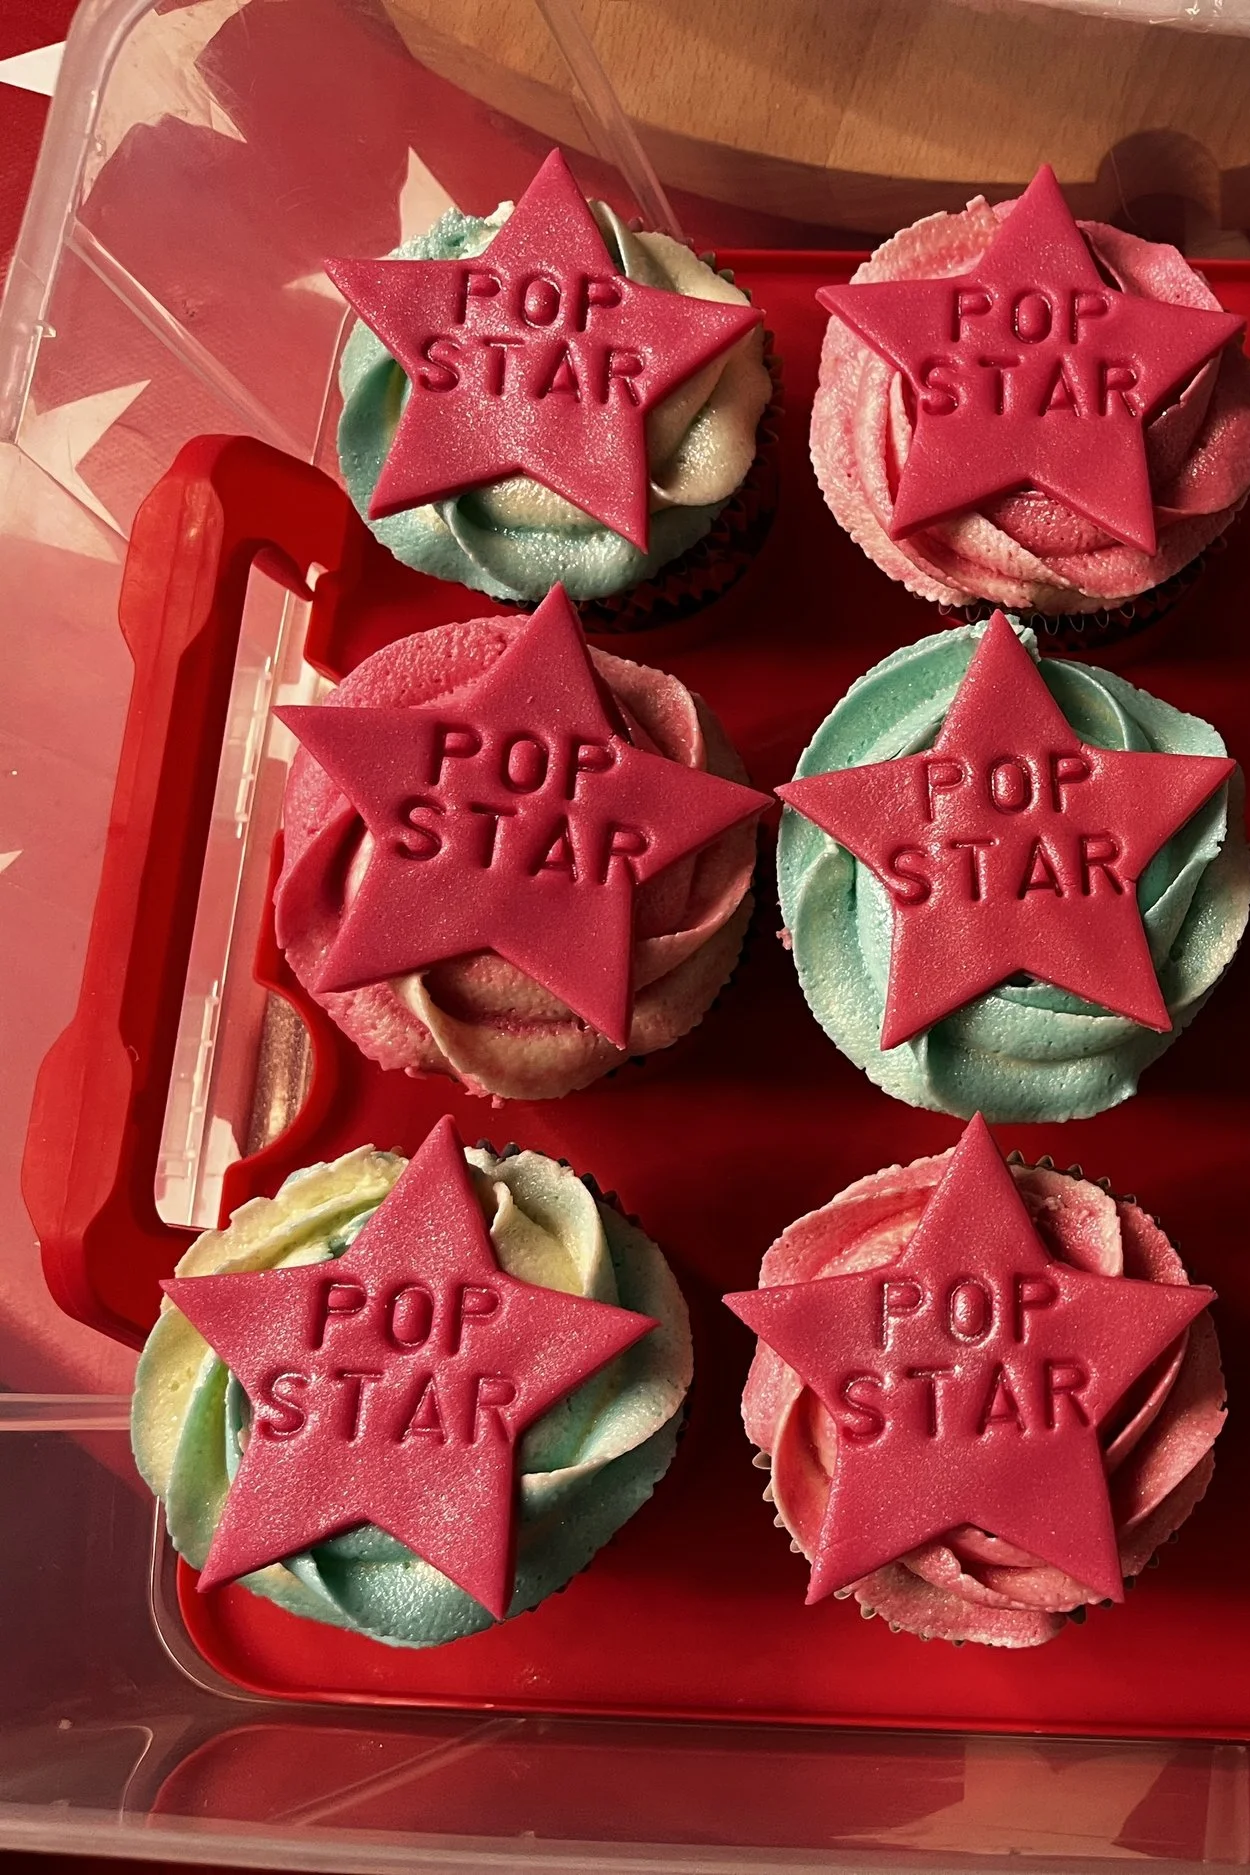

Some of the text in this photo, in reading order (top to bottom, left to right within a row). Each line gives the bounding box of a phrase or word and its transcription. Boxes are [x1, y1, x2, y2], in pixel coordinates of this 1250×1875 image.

[458, 270, 620, 333] POP
[953, 286, 1110, 344] POP
[422, 338, 648, 405] STAR
[923, 360, 1141, 417] STAR
[432, 727, 617, 801] POP
[926, 754, 1091, 820] POP
[397, 800, 647, 885] STAR
[891, 837, 1126, 904] STAR
[311, 1282, 498, 1354] POP
[880, 1279, 1058, 1351] POP
[259, 1369, 521, 1443] STAR
[840, 1362, 1092, 1439] STAR
